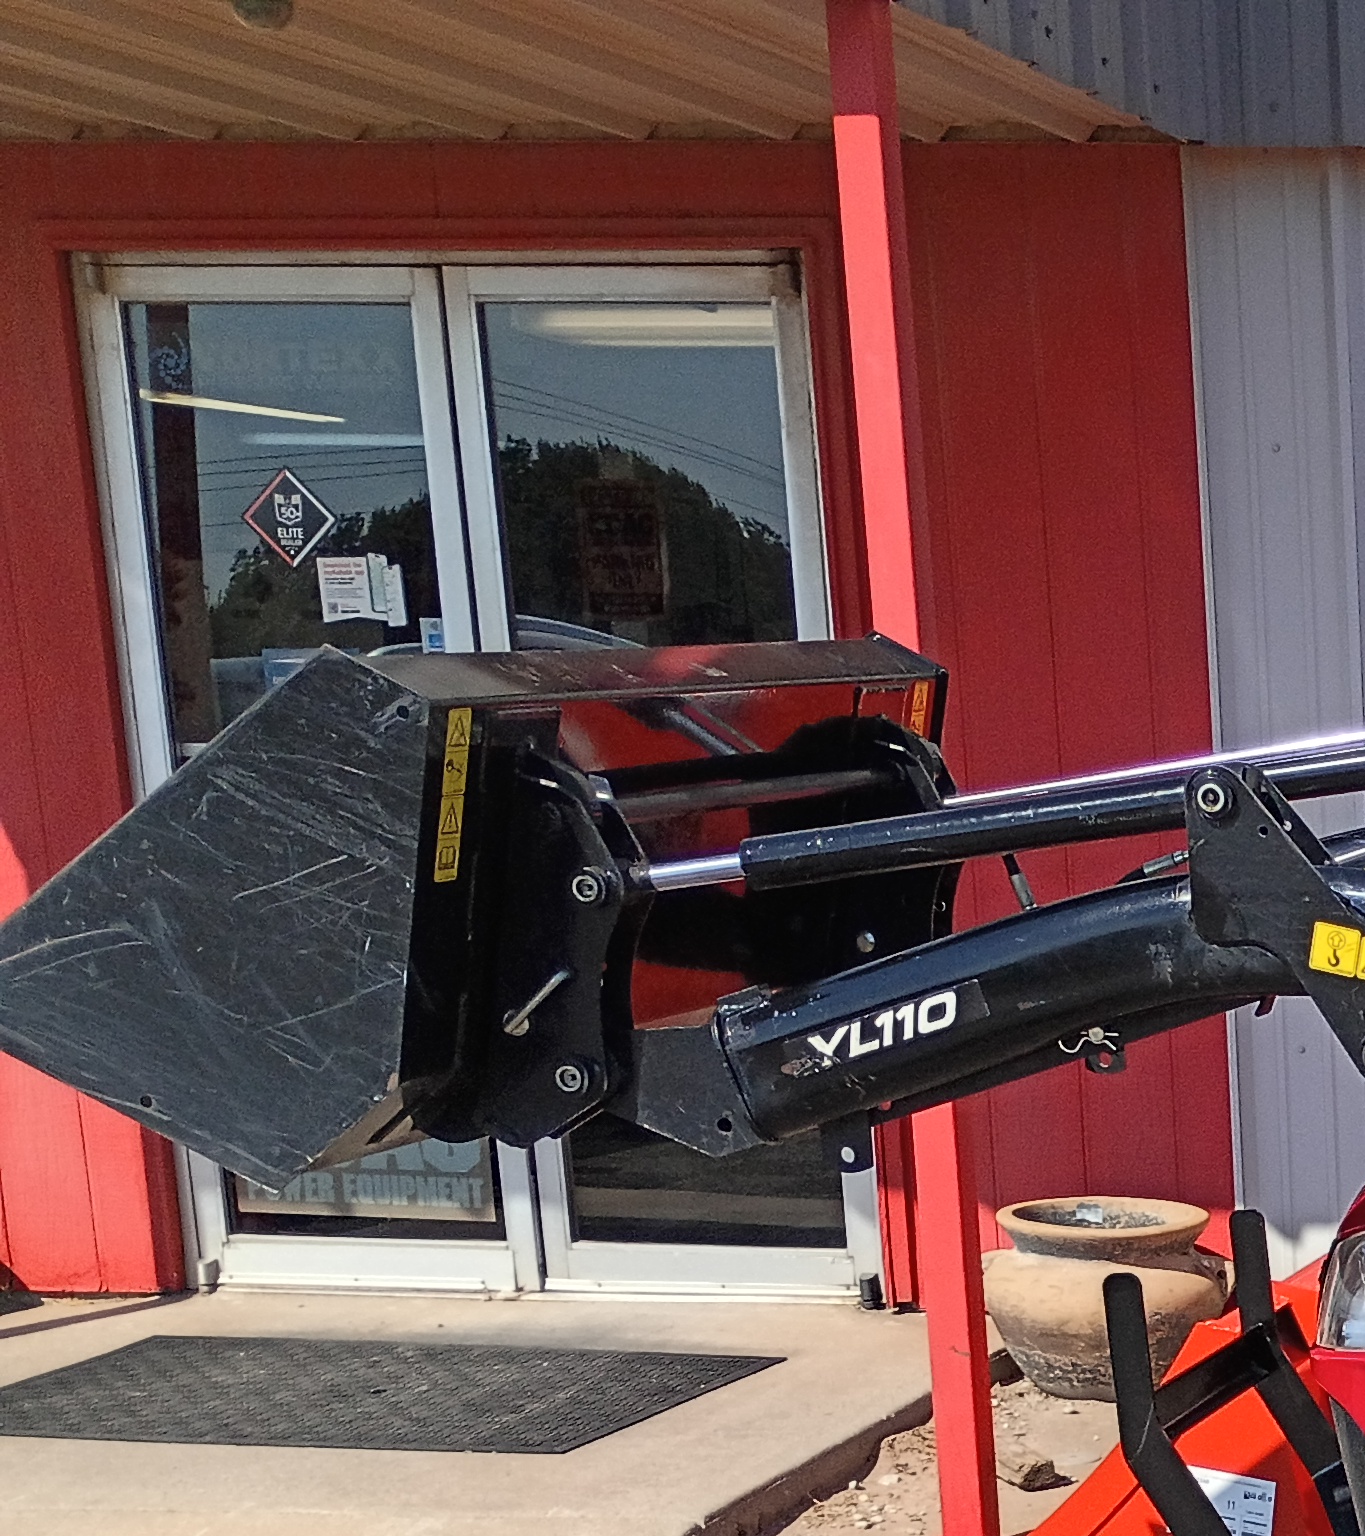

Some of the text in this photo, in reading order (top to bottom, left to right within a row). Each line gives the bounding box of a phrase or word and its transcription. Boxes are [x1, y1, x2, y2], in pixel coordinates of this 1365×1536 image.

[277, 527, 304, 539] ELITE
[806, 990, 957, 1068] YL110
[247, 1172, 484, 1209] PWER EQUIPMENT
